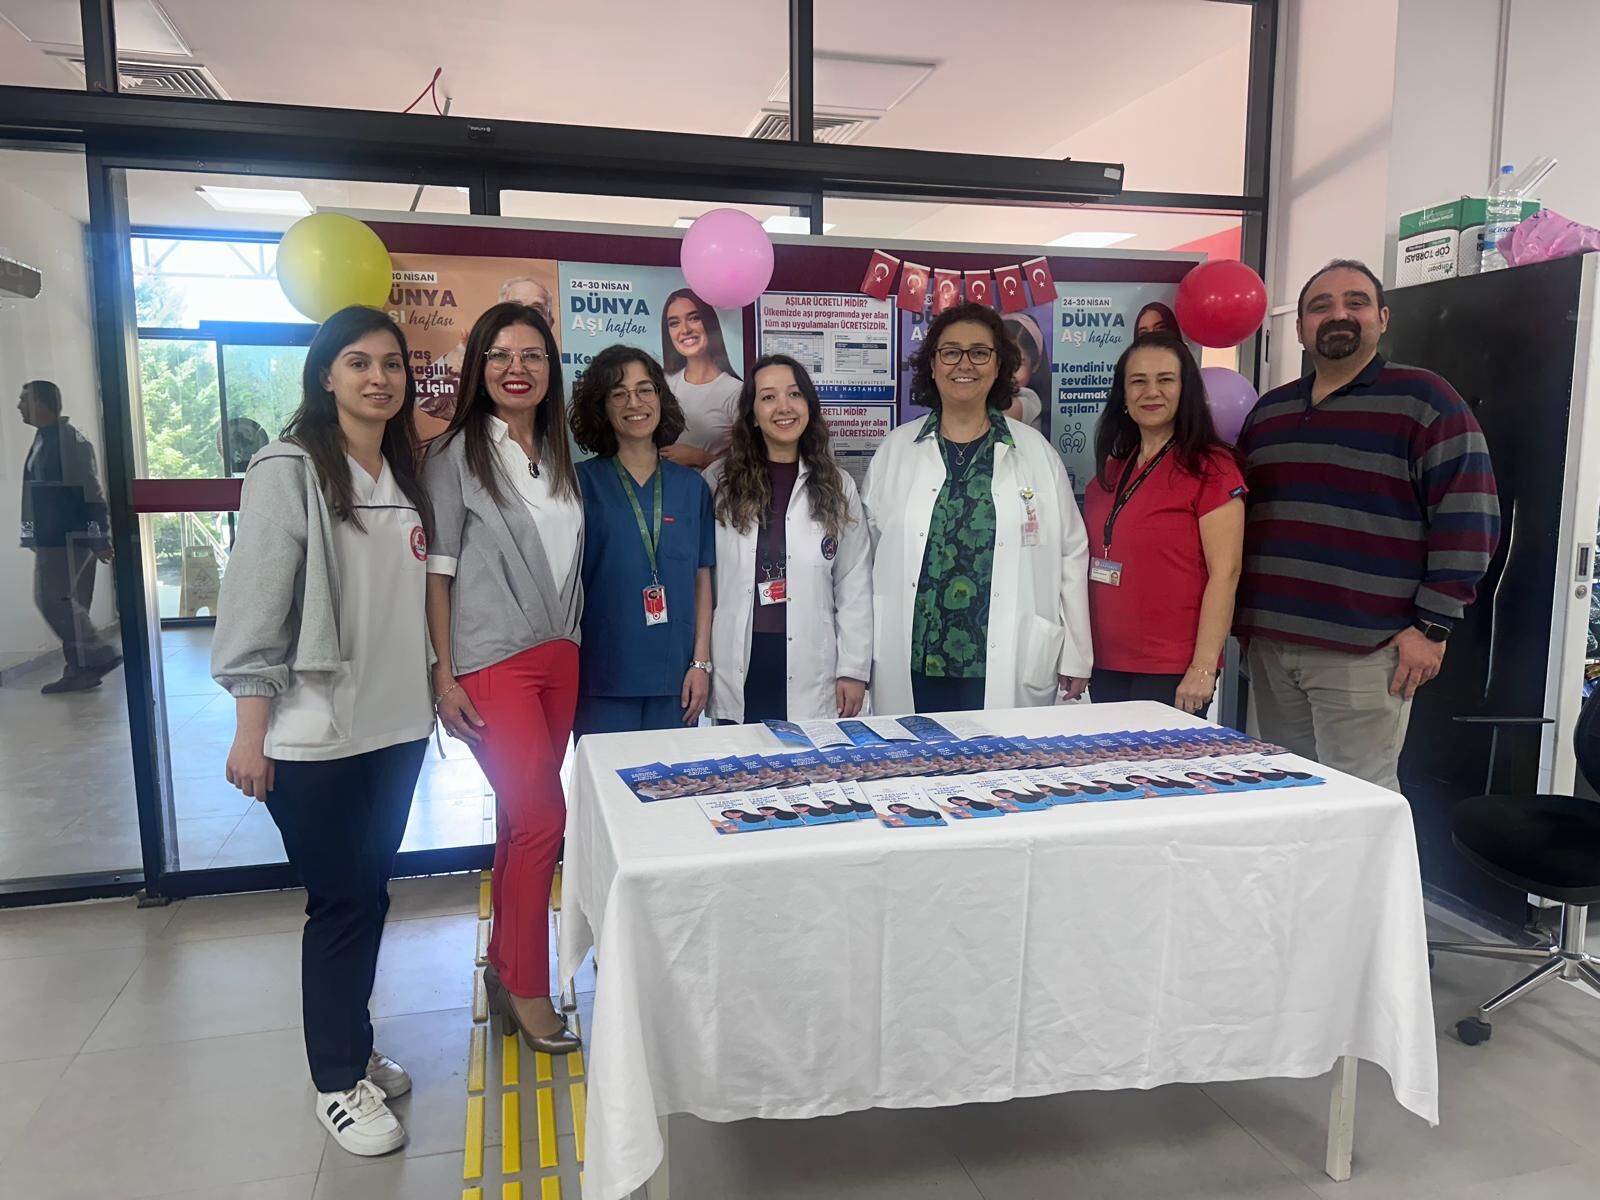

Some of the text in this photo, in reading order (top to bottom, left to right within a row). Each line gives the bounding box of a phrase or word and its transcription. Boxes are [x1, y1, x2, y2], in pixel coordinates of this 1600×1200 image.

[1404, 249, 1433, 264] TORBASI
[403, 272, 435, 282] NİSAN
[571, 280, 630, 291] 24-30 NİSAN
[389, 283, 458, 308] ÜNYA
[785, 295, 868, 308] AŞILAR ÜCRETLİ MİDİR?
[1063, 298, 1086, 306] 24-30
[570, 292, 650, 316] DÜNYA
[763, 306, 889, 320] Ülkemizde aşı programında yer alan
[1062, 309, 1125, 328] DÜNYA
[408, 310, 455, 331] haftası
[764, 319, 888, 331] tüm aşı uygulamaları ÜCRETSİZDİR.
[605, 318, 648, 338] haftası
[1088, 330, 1122, 348] haftası
[1061, 361, 1104, 373] Kendini
[1061, 374, 1113, 386] sevdikler
[426, 380, 454, 397] için
[1060, 390, 1108, 400] korumak
[820, 407, 867, 416] CRETLİ MİDİR?
[1060, 402, 1099, 417] aşılan!
[827, 419, 888, 428] gramında yer alan
[840, 428, 887, 437] ÜCRETSİZDİR.
